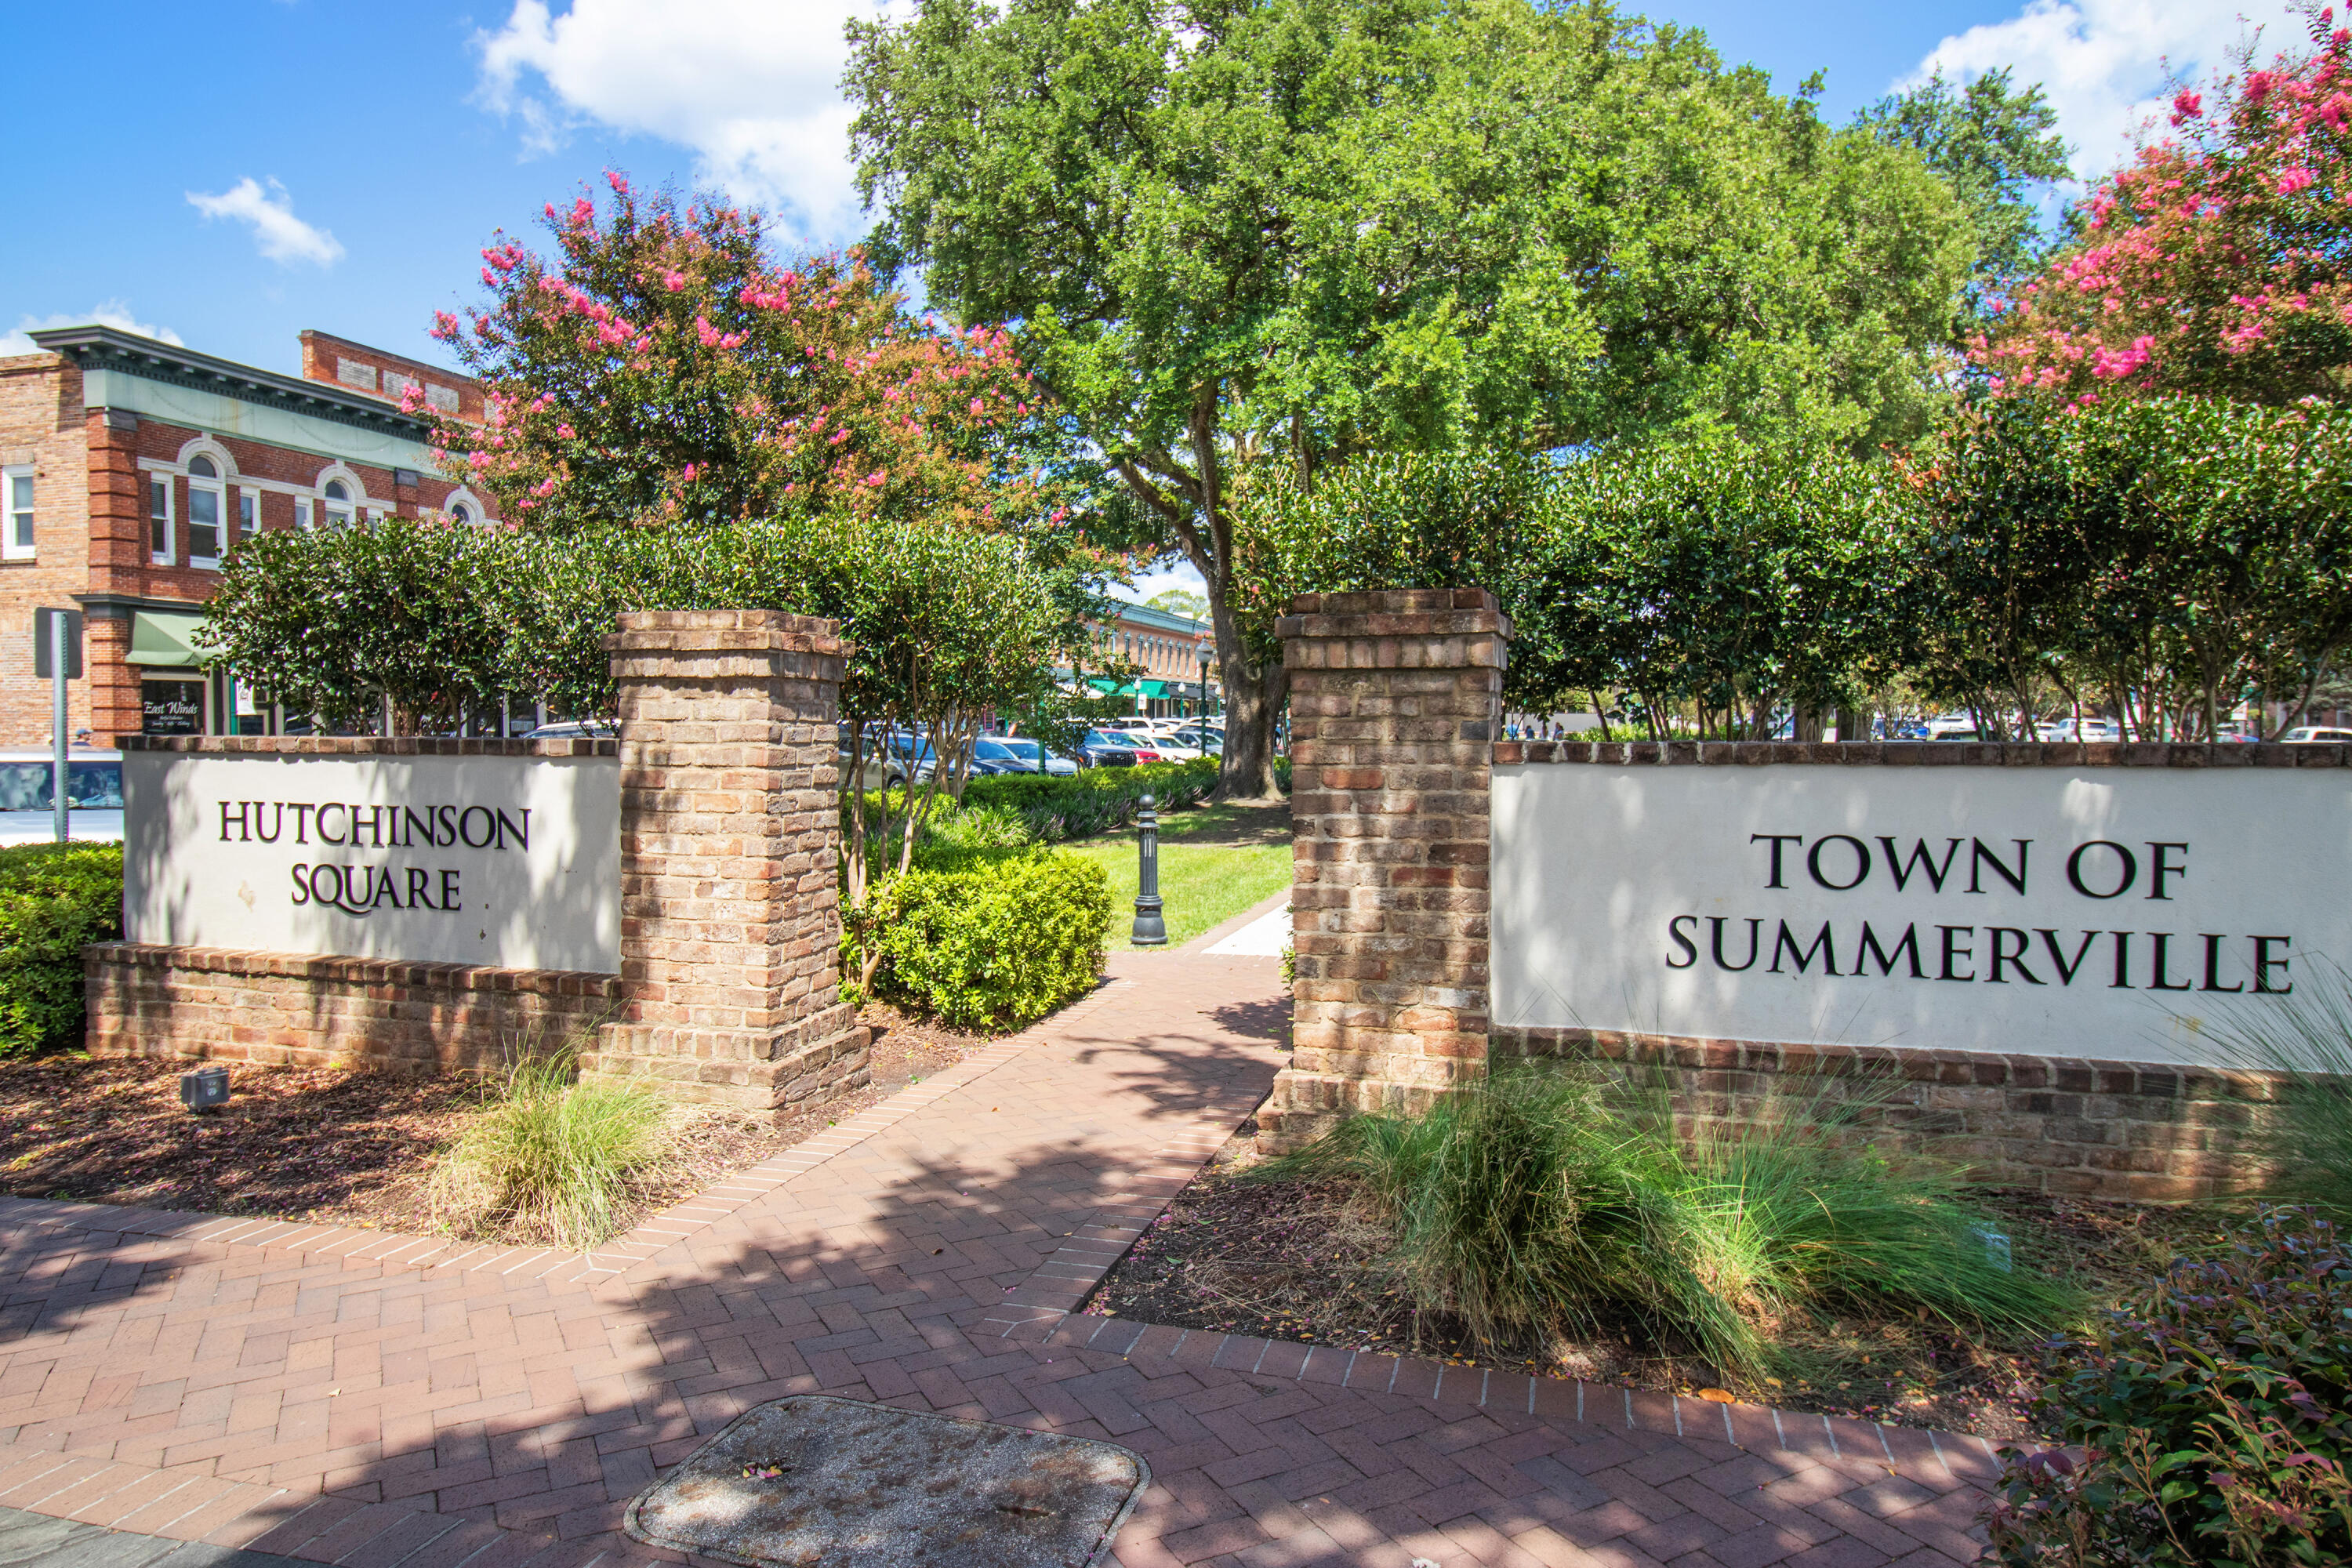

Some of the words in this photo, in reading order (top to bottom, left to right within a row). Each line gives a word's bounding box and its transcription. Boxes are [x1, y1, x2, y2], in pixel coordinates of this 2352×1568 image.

[143, 701, 165, 714] East
[166, 701, 198, 714] Winds
[218, 801, 532, 852] HUTCHINSON
[292, 863, 462, 918] SQUARE
[1750, 833, 2034, 896] TOWN
[2067, 840, 2189, 900] OF
[1666, 915, 2293, 994] SUMMERVILLE
